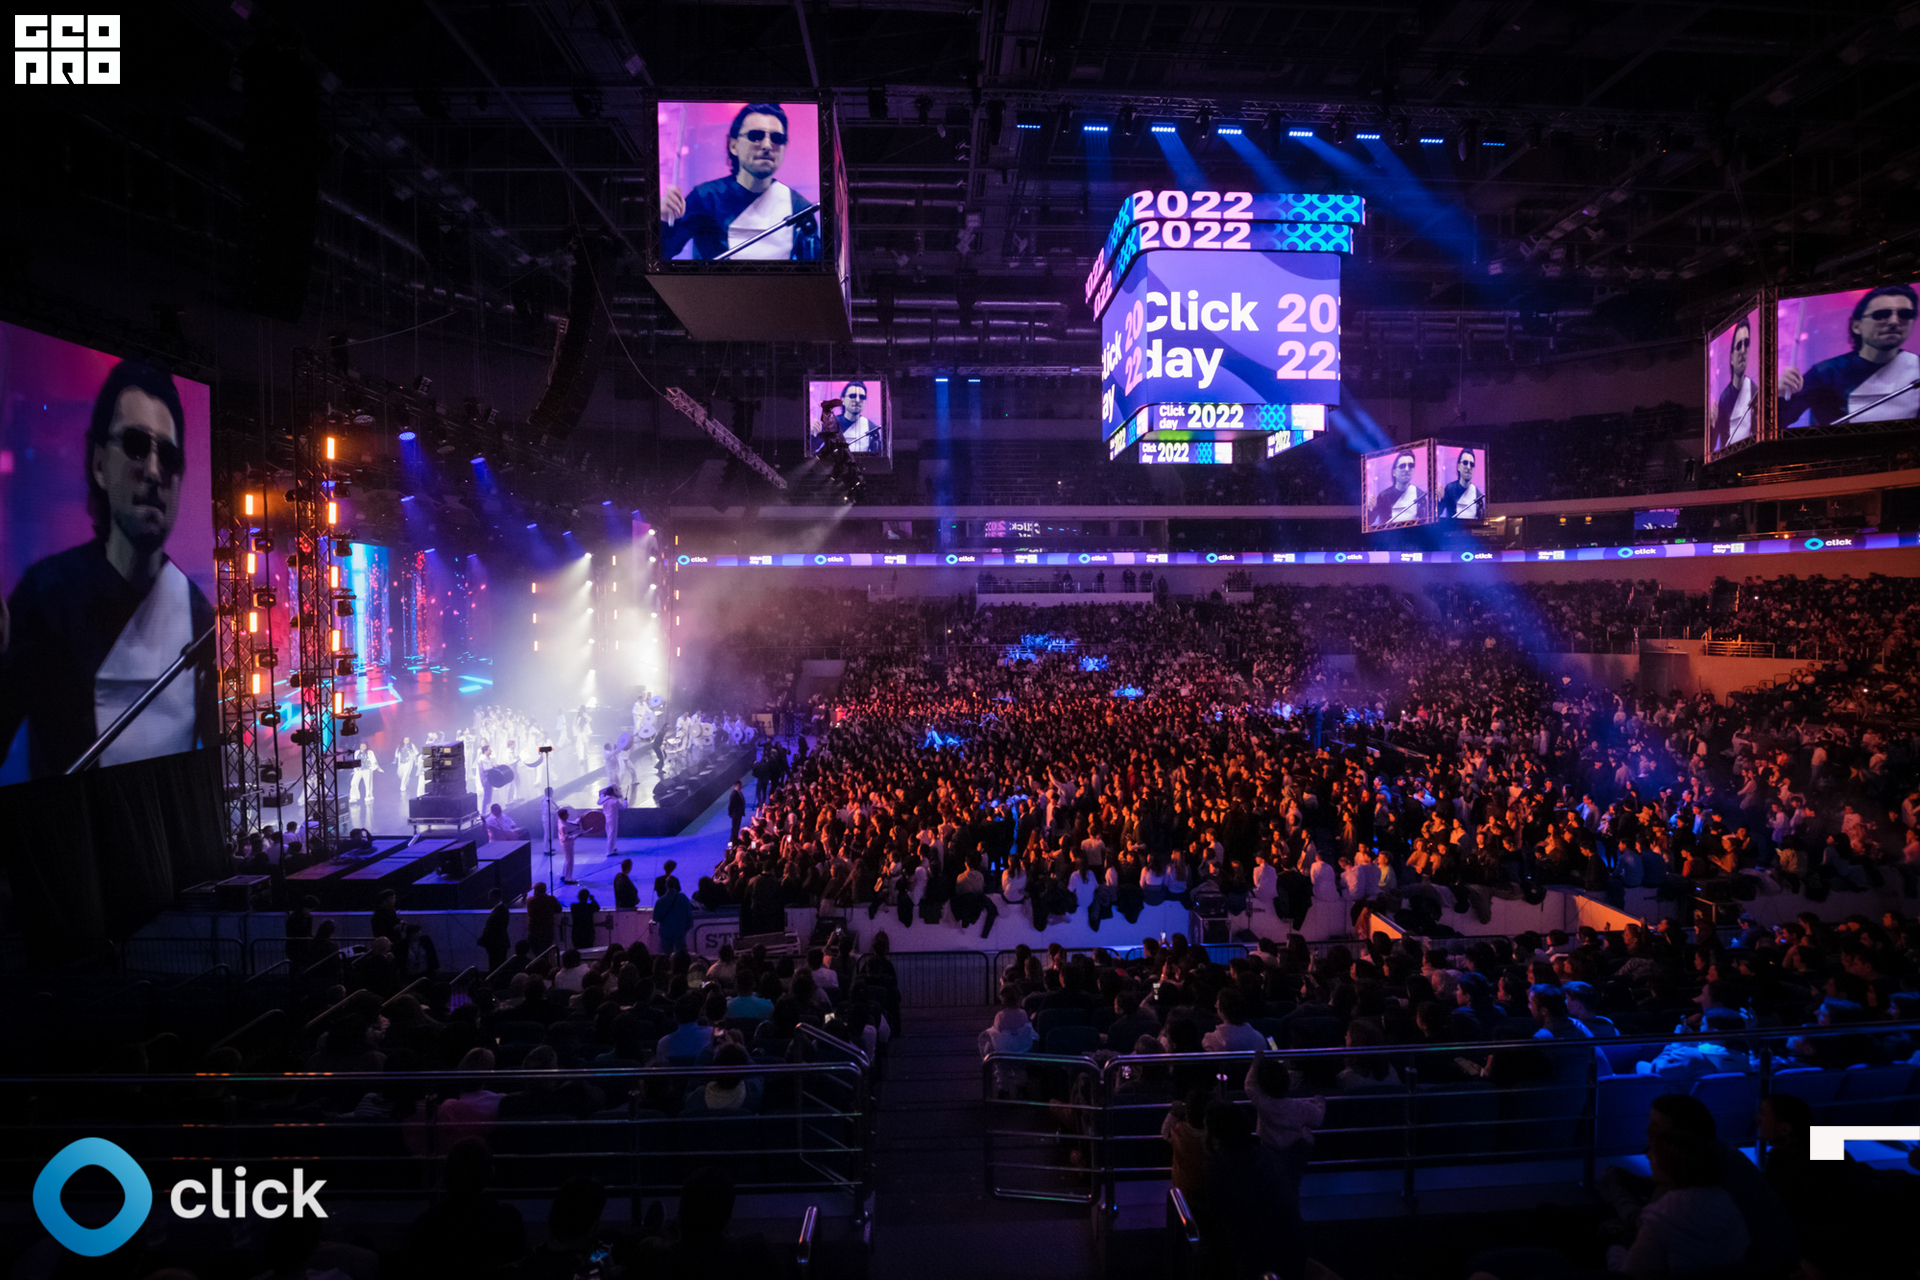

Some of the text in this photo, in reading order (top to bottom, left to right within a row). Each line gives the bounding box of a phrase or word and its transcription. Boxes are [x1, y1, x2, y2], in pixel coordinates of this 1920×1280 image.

[1133, 190, 1253, 220] 2022
[1140, 221, 1251, 250] 2022
[1093, 270, 1113, 322] 022
[1146, 290, 1259, 332] Click
[1277, 293, 1337, 333] 20
[1125, 299, 1144, 353] 20
[1102, 330, 1123, 382] lick
[1125, 346, 1143, 397] 22
[1146, 338, 1224, 389] day
[1277, 340, 1336, 380] 22
[1159, 404, 1186, 417] Click
[1159, 417, 1179, 431] day
[1187, 404, 1244, 429] 2022
[1157, 442, 1190, 463] 2022
[1825, 538, 1852, 546] click
